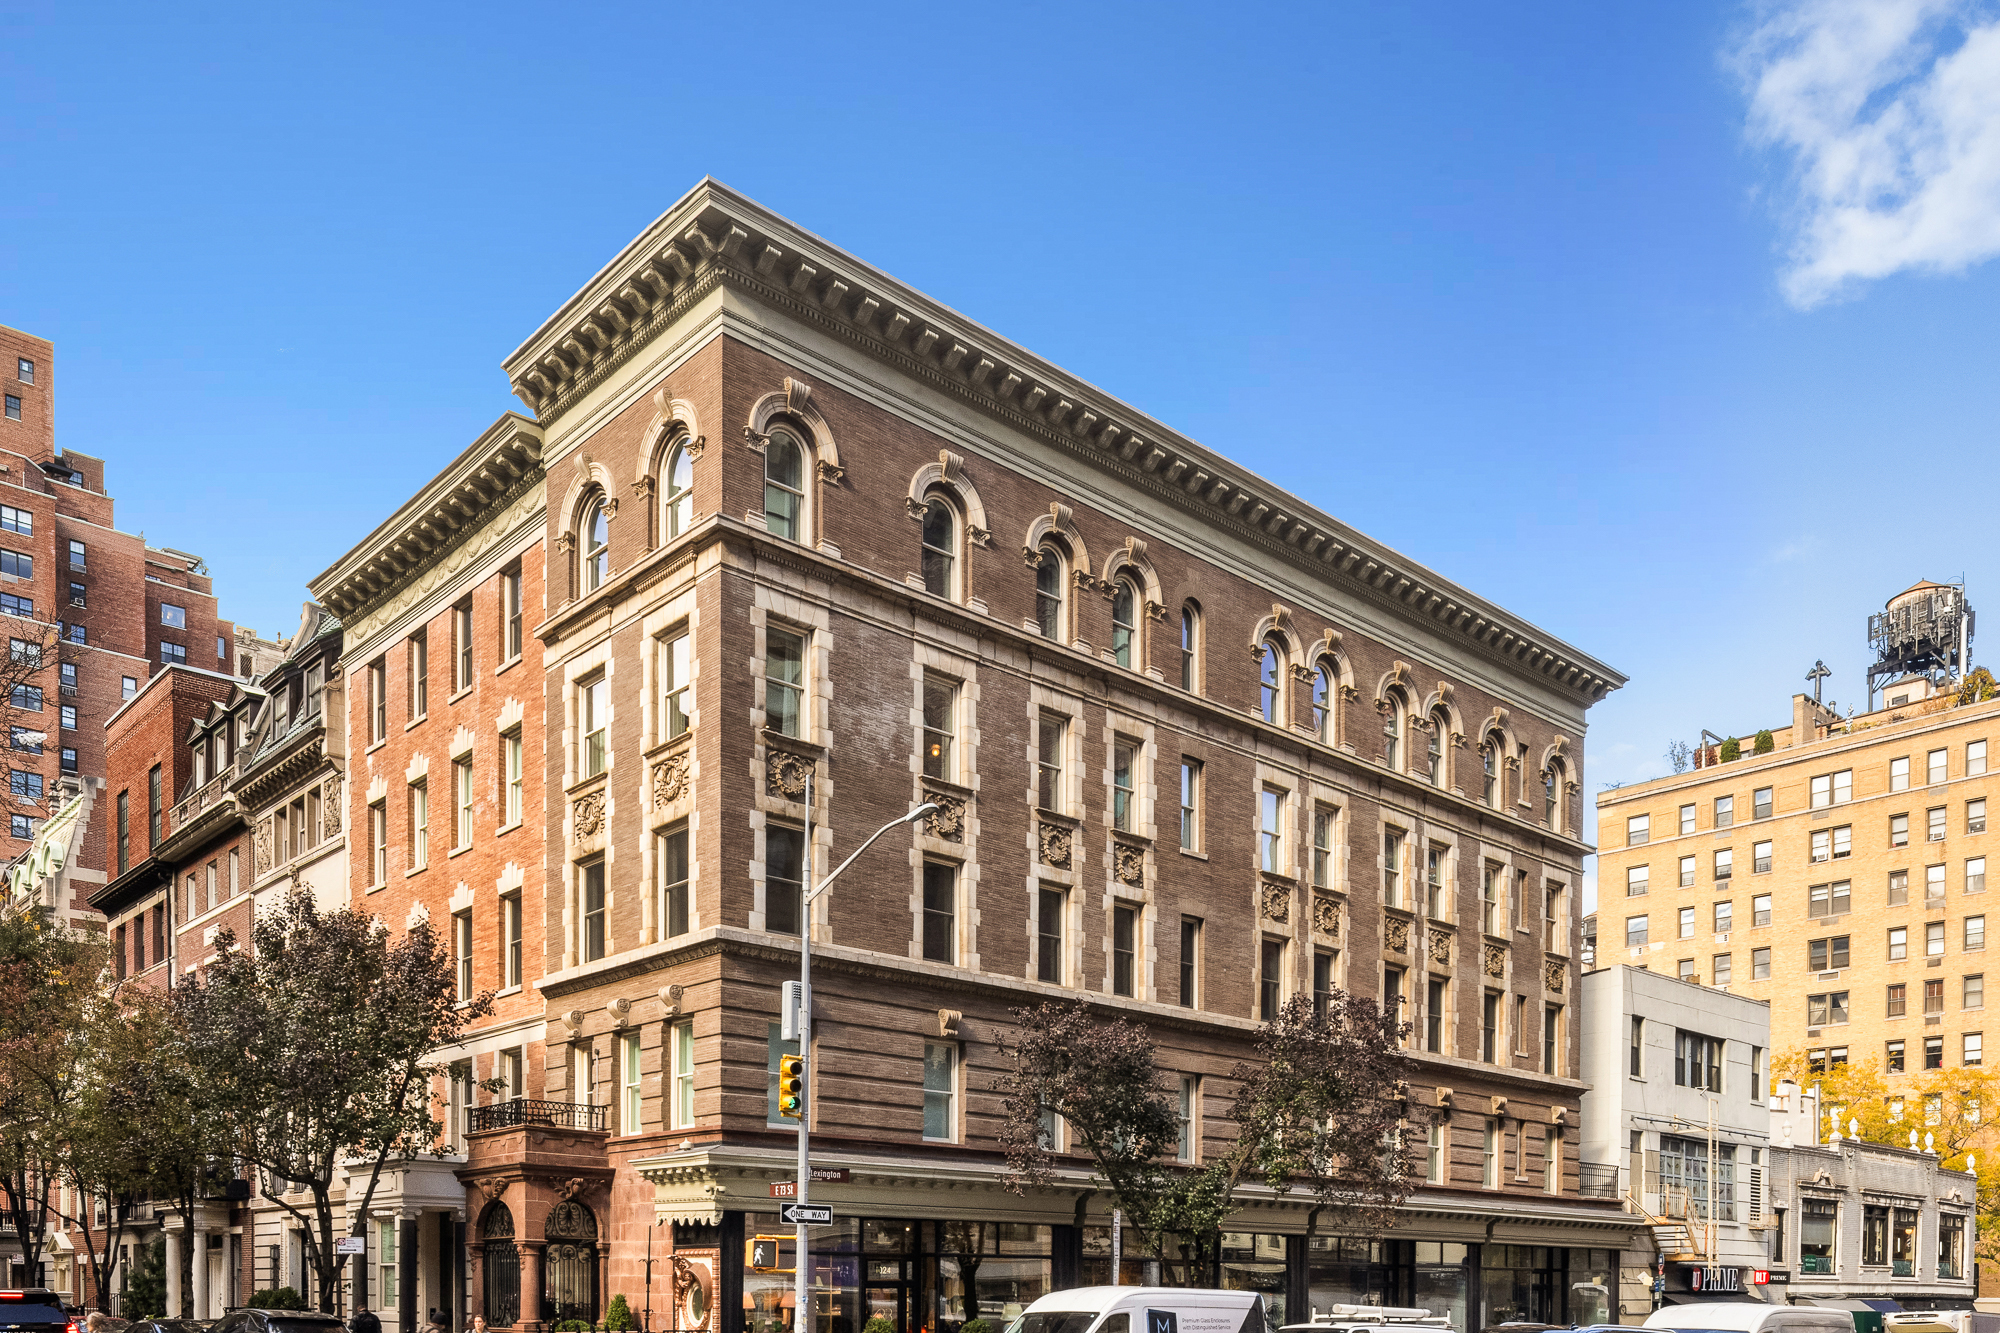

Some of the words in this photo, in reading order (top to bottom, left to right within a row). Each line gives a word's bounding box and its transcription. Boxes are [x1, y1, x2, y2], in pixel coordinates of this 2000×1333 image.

[810, 1169, 841, 1180] Lexington
[775, 1185, 779, 1196] E
[780, 1185, 786, 1195] 73
[787, 1184, 794, 1195] St
[790, 1210, 805, 1218] ONE
[811, 1211, 827, 1219] WAY
[1755, 1271, 1767, 1283] BLT
[1156, 1318, 1170, 1333] M
